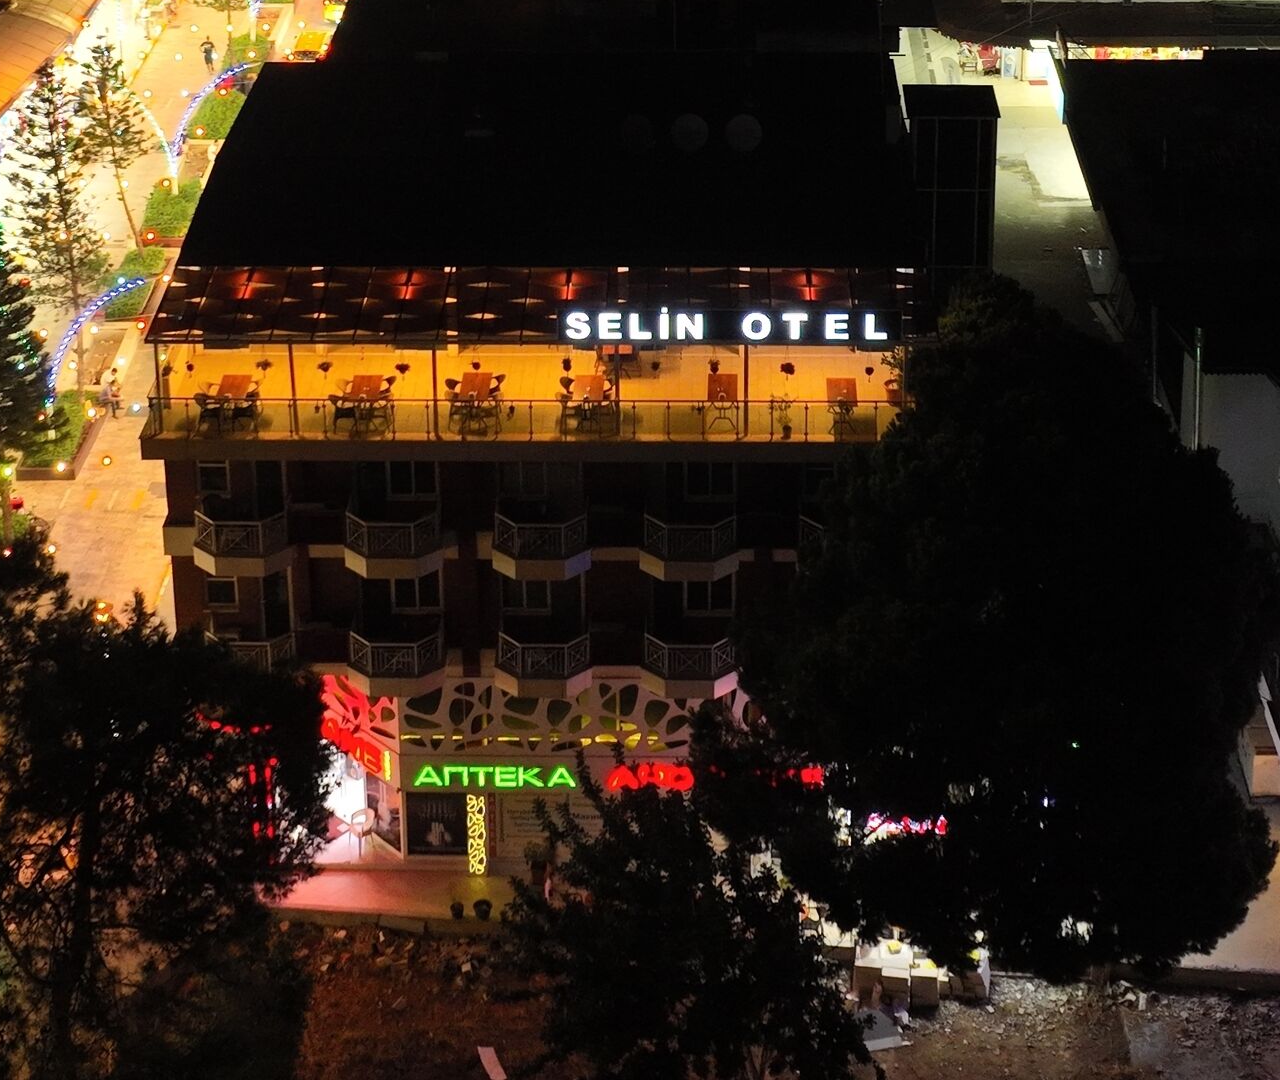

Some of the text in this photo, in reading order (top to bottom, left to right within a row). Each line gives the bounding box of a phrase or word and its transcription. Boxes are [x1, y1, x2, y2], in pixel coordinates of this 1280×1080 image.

[565, 306, 888, 341] SELİN OTEL
[413, 763, 577, 788] АПТЕКА
